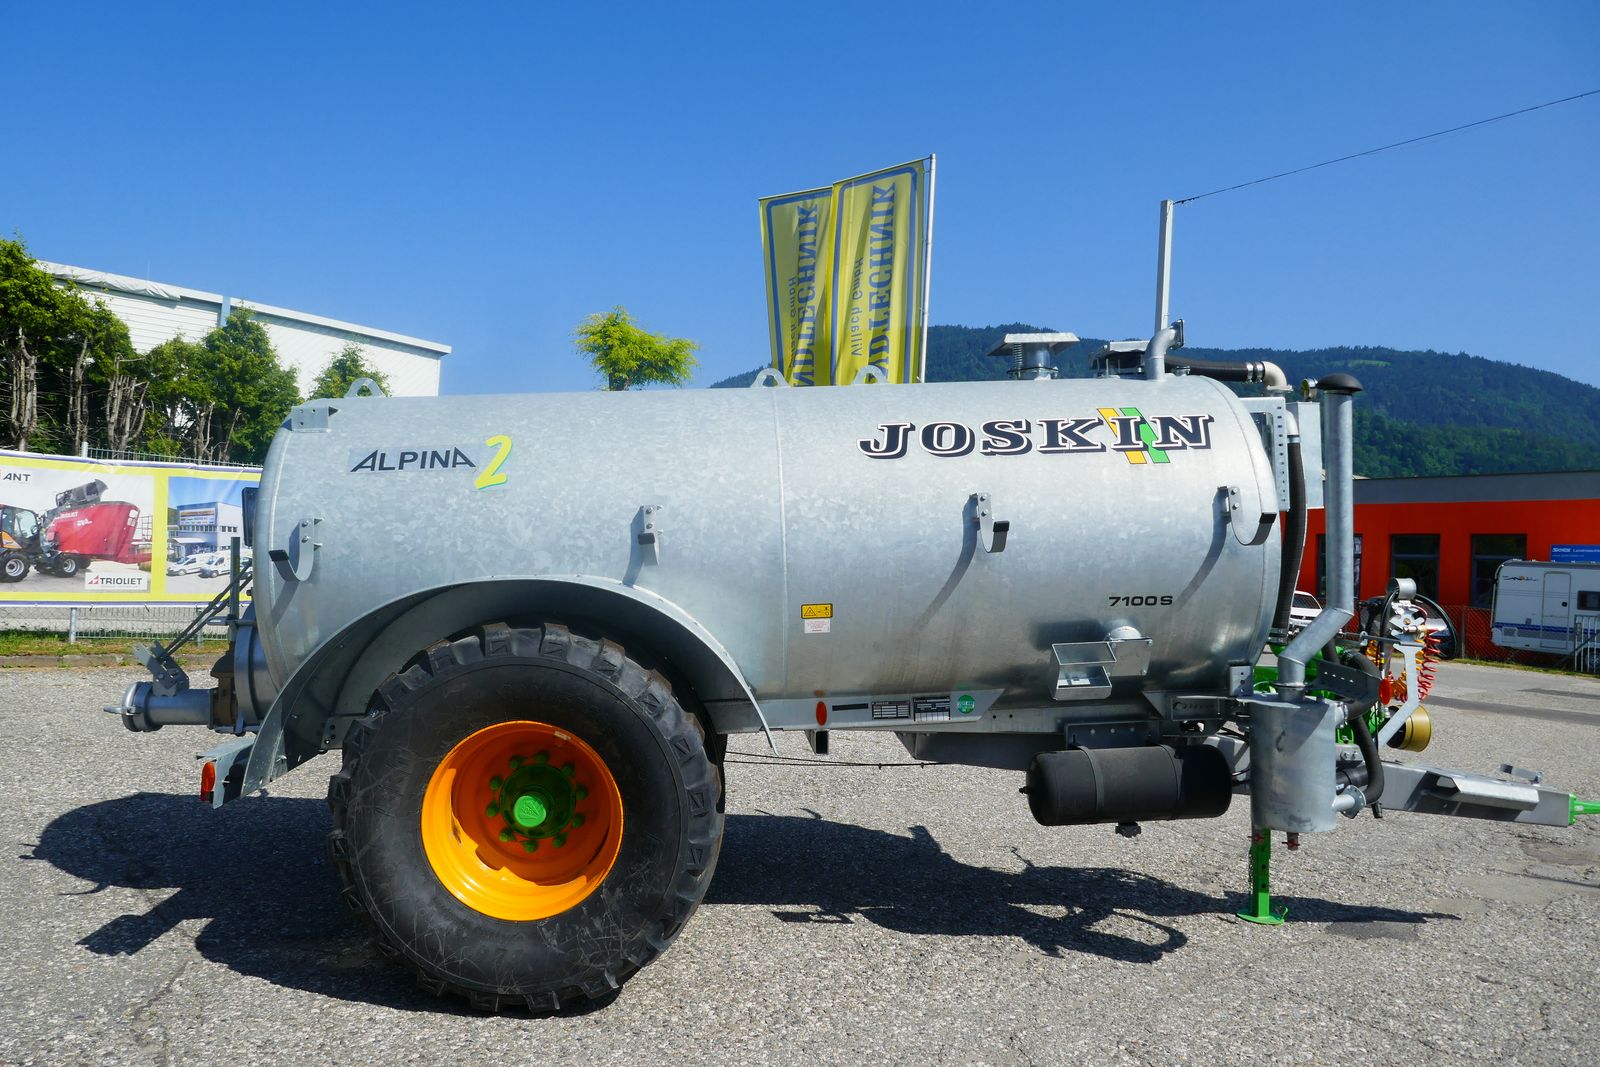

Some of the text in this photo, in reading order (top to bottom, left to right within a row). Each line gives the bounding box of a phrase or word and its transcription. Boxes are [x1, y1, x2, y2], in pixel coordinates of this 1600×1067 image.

[857, 413, 1215, 460] JOSKIN
[350, 434, 512, 490] ALPINA 2
[100, 577, 143, 585] TRIOLIET
